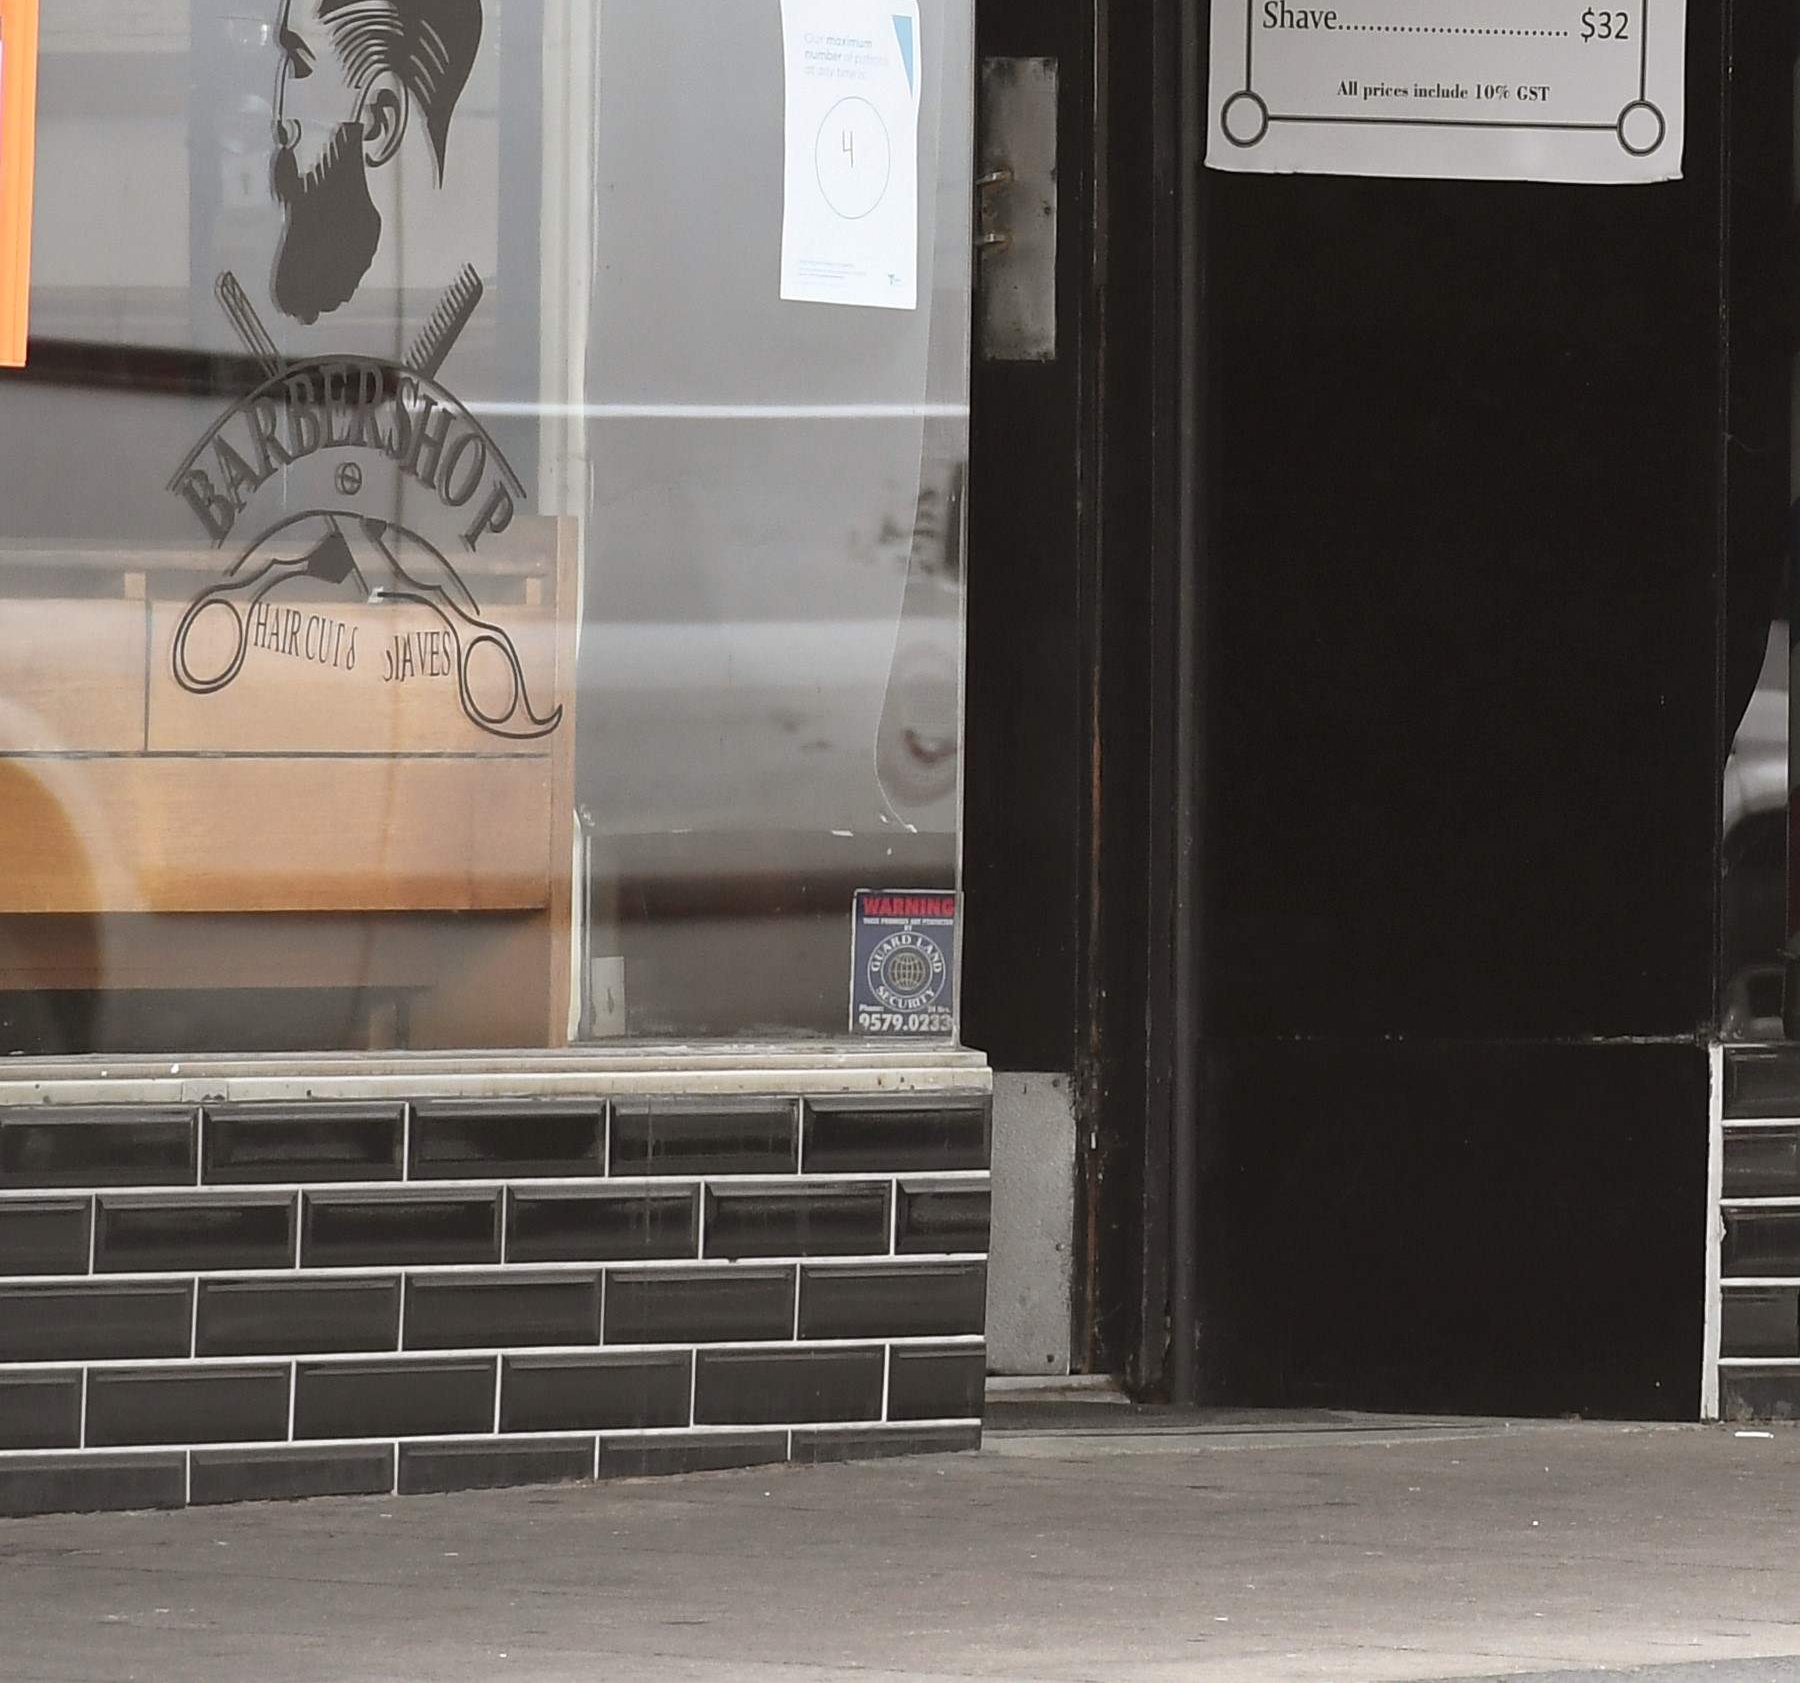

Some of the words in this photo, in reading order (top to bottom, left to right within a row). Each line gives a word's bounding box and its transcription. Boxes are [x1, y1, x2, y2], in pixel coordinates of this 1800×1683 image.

[1262, 0, 1338, 31] Shave
[1580, 7, 1629, 43] $32
[1337, 80, 1358, 98] All
[1363, 81, 1409, 103] prices
[1413, 83, 1469, 100] include
[1475, 84, 1511, 101] 10%
[1516, 85, 1550, 102] GST
[842, 128, 854, 169] 4
[180, 362, 515, 554] BARBERSHOP
[863, 896, 955, 917] WARNING
[871, 934, 912, 973] GUARD
[916, 937, 942, 973] LAND
[876, 985, 935, 1009] SECURITY
